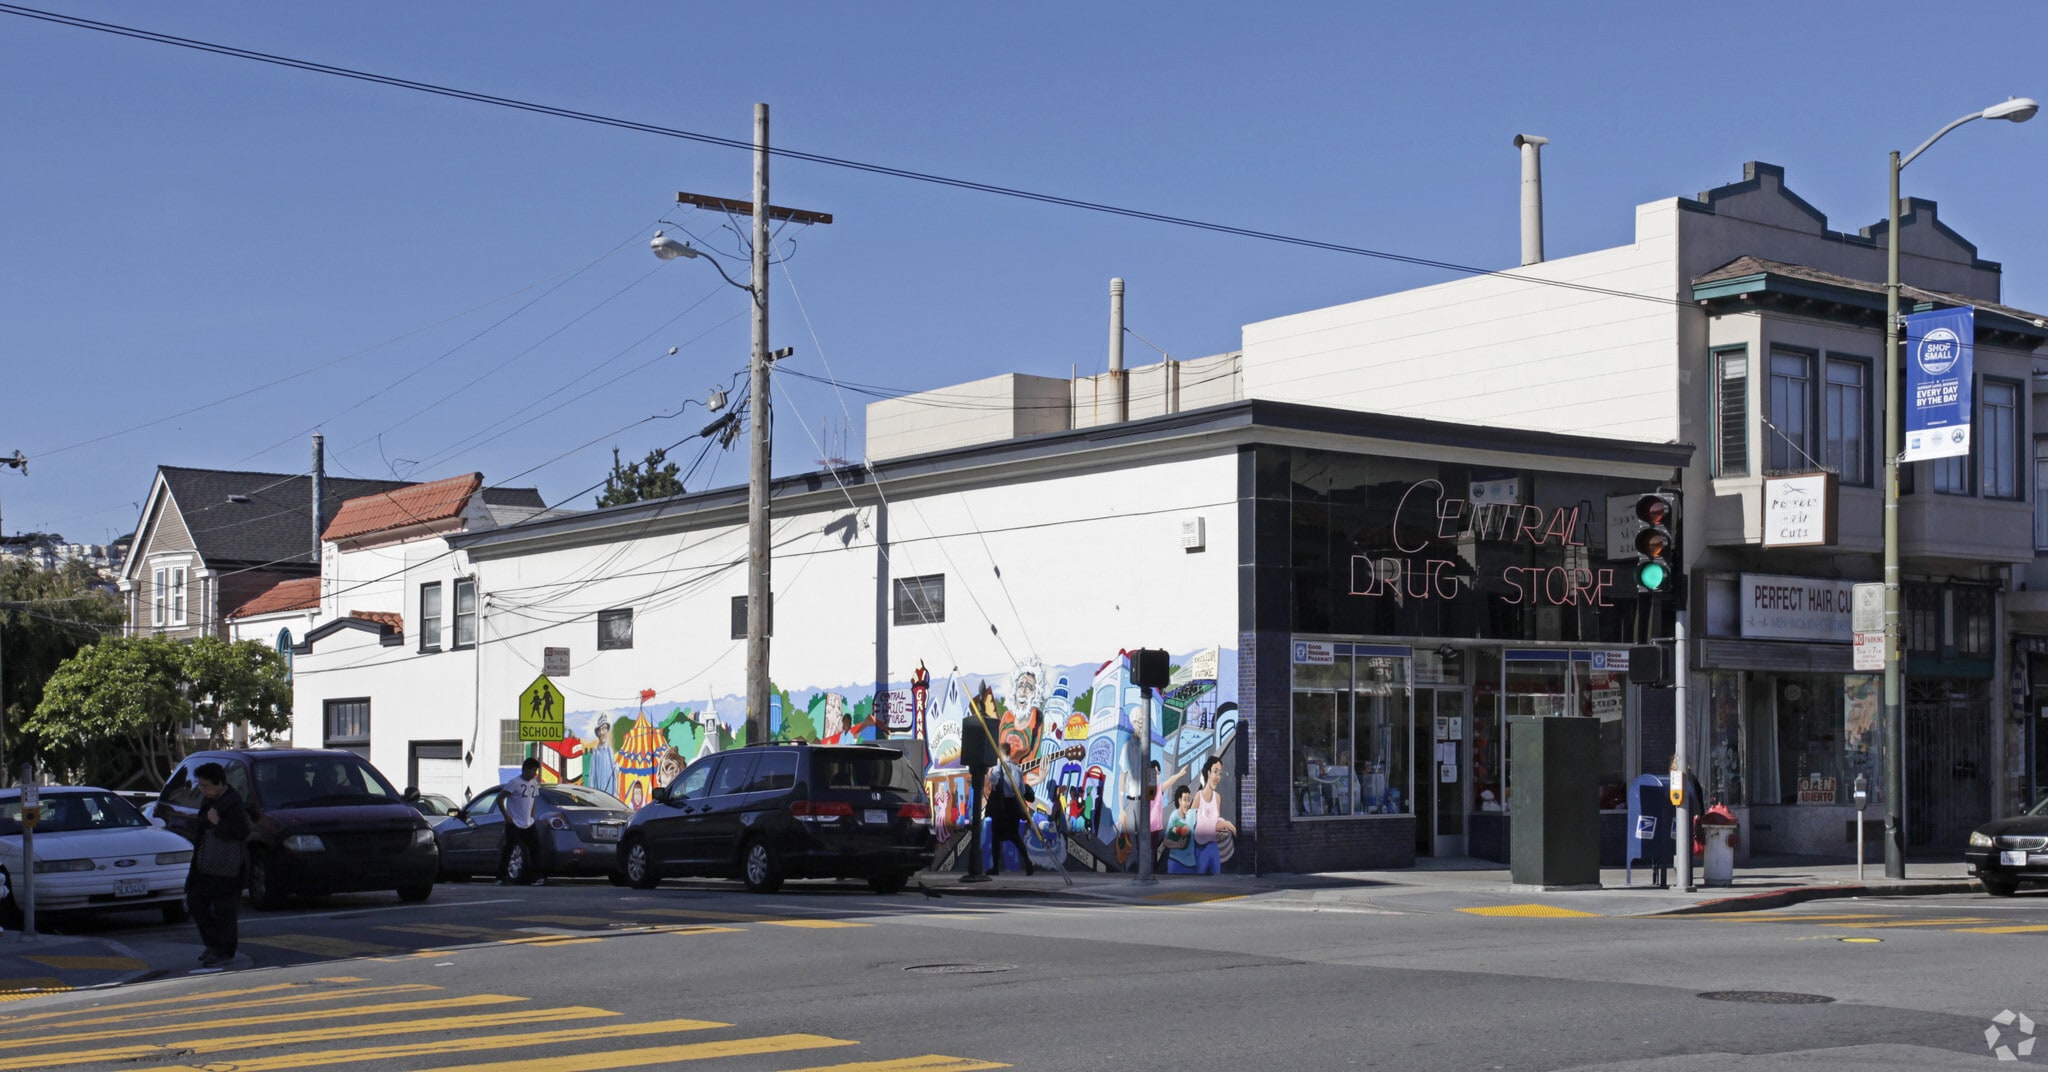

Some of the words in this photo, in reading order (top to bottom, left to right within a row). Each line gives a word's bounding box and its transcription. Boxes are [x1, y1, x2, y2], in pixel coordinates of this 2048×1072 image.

[1927, 342, 1951, 353] SHOP
[1924, 351, 1952, 361] SMALL
[1917, 388, 1941, 398] EVERY
[1943, 385, 1958, 395] DAY
[1917, 397, 1927, 407] BY
[1928, 396, 1942, 405] THE
[1943, 393, 1958, 403] BAY
[1393, 478, 1585, 553] CENTRAL
[1349, 554, 1459, 600] DRUG
[1500, 565, 1615, 607] STORE
[1754, 585, 1803, 611] PERFECT
[1808, 588, 1833, 612] HAIR
[1837, 590, 1853, 614] CU
[1855, 634, 1864, 645] NO
[1865, 635, 1884, 644] PARKING
[880, 690, 906, 701] CENTRAL
[917, 689, 925, 740] GRANA
[522, 726, 561, 738] SCHOOL
[1801, 793, 1834, 802] ABIERTO
